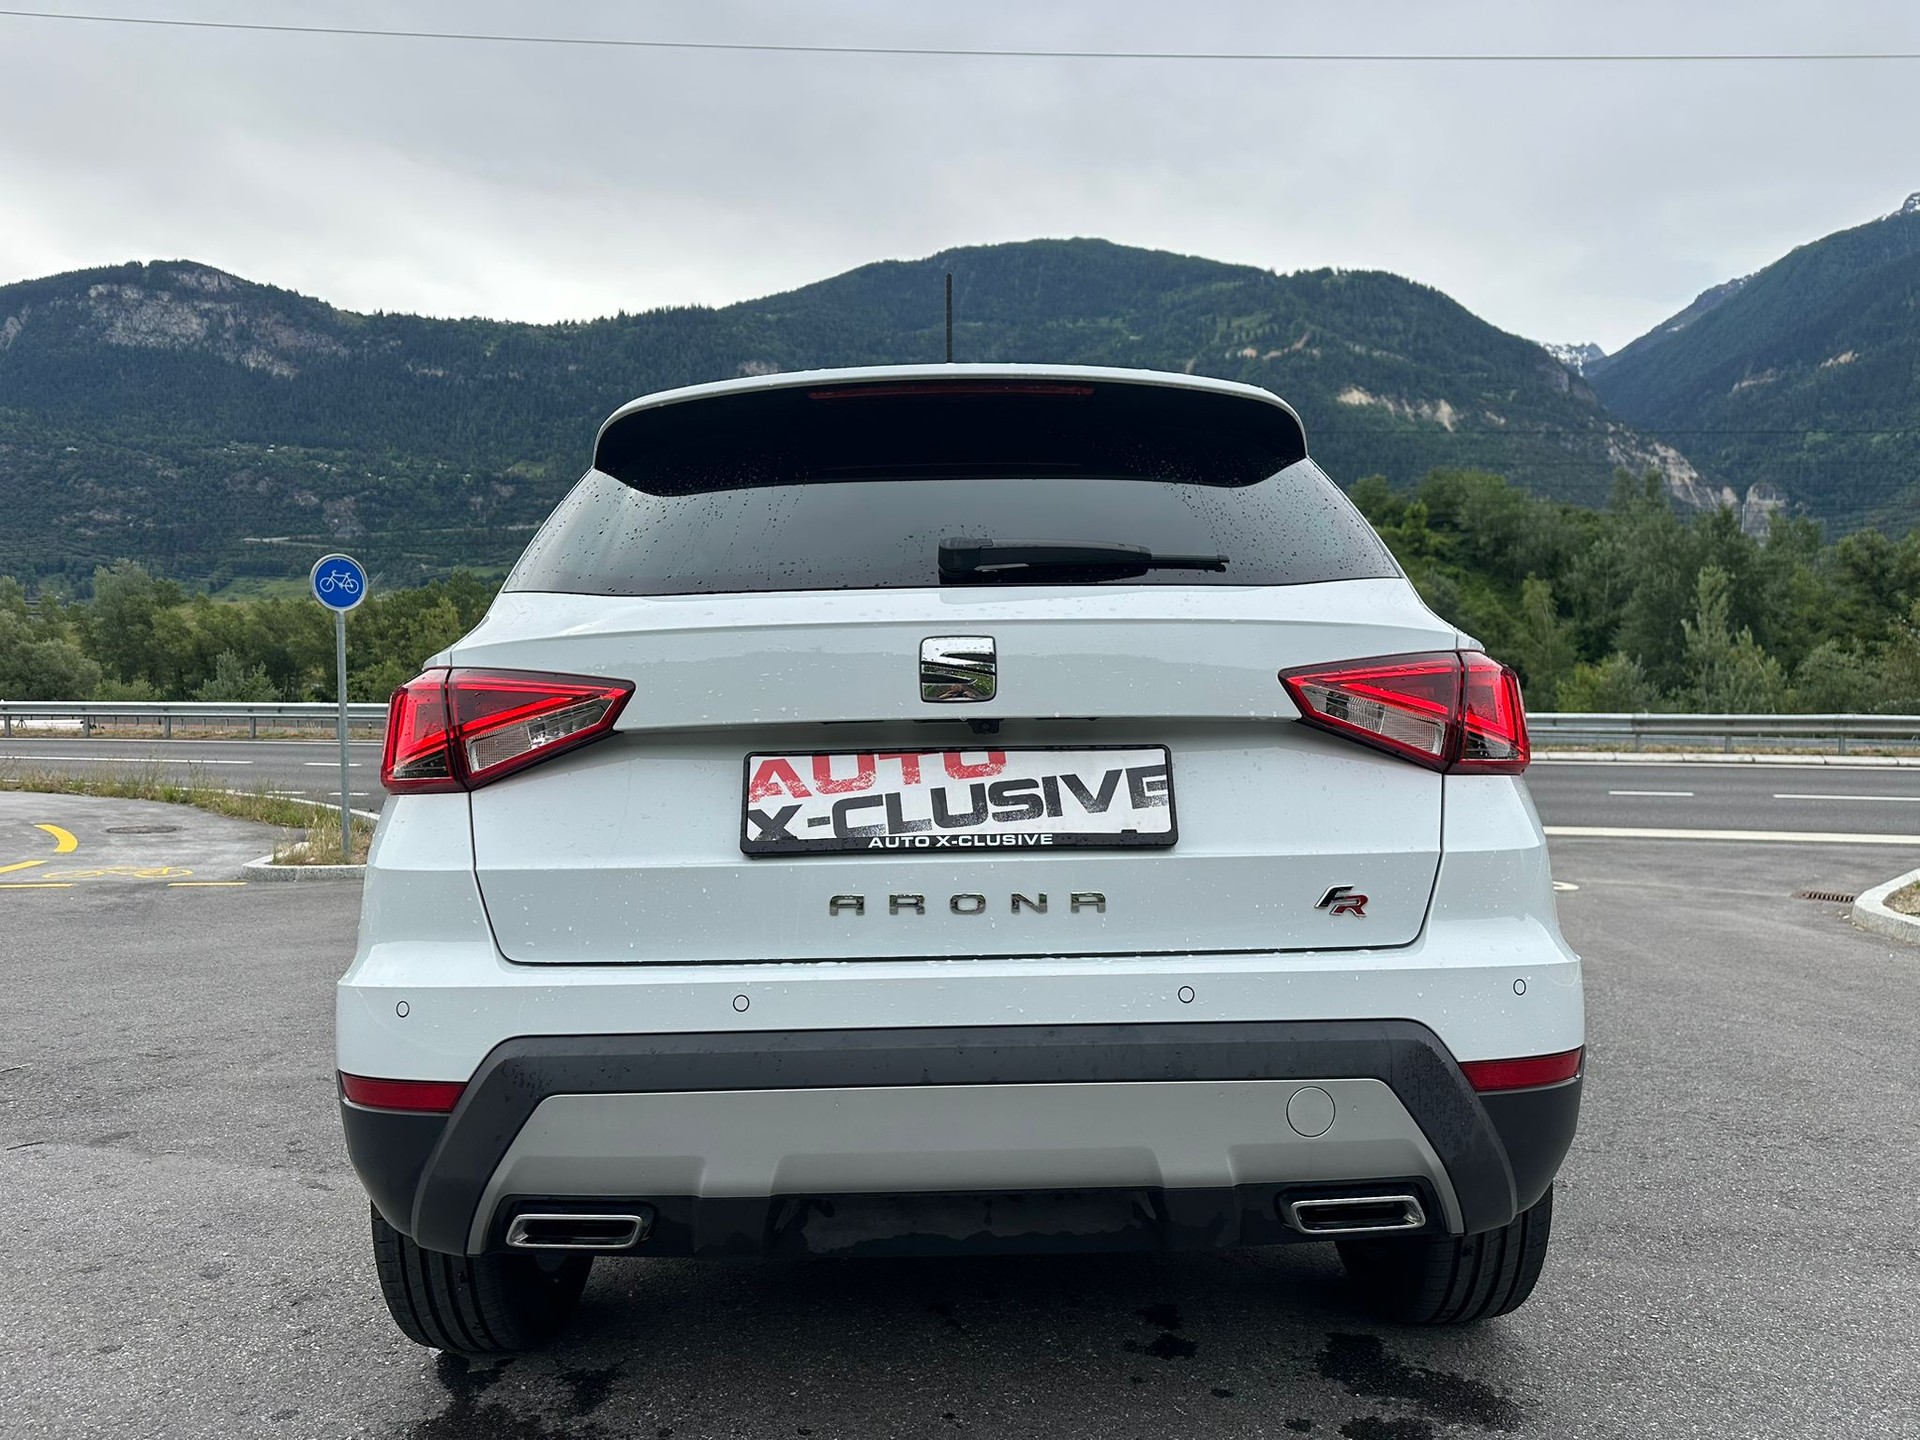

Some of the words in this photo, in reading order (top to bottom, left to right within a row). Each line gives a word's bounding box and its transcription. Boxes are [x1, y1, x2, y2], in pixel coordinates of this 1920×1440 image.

[748, 750, 1006, 803] AUTO
[748, 764, 1168, 841] X-CLUSIVE
[868, 836, 930, 849] AUTO
[937, 834, 1053, 847] X-CLUSIVE
[829, 891, 1106, 916] ARONA
[1314, 884, 1369, 918] FR
